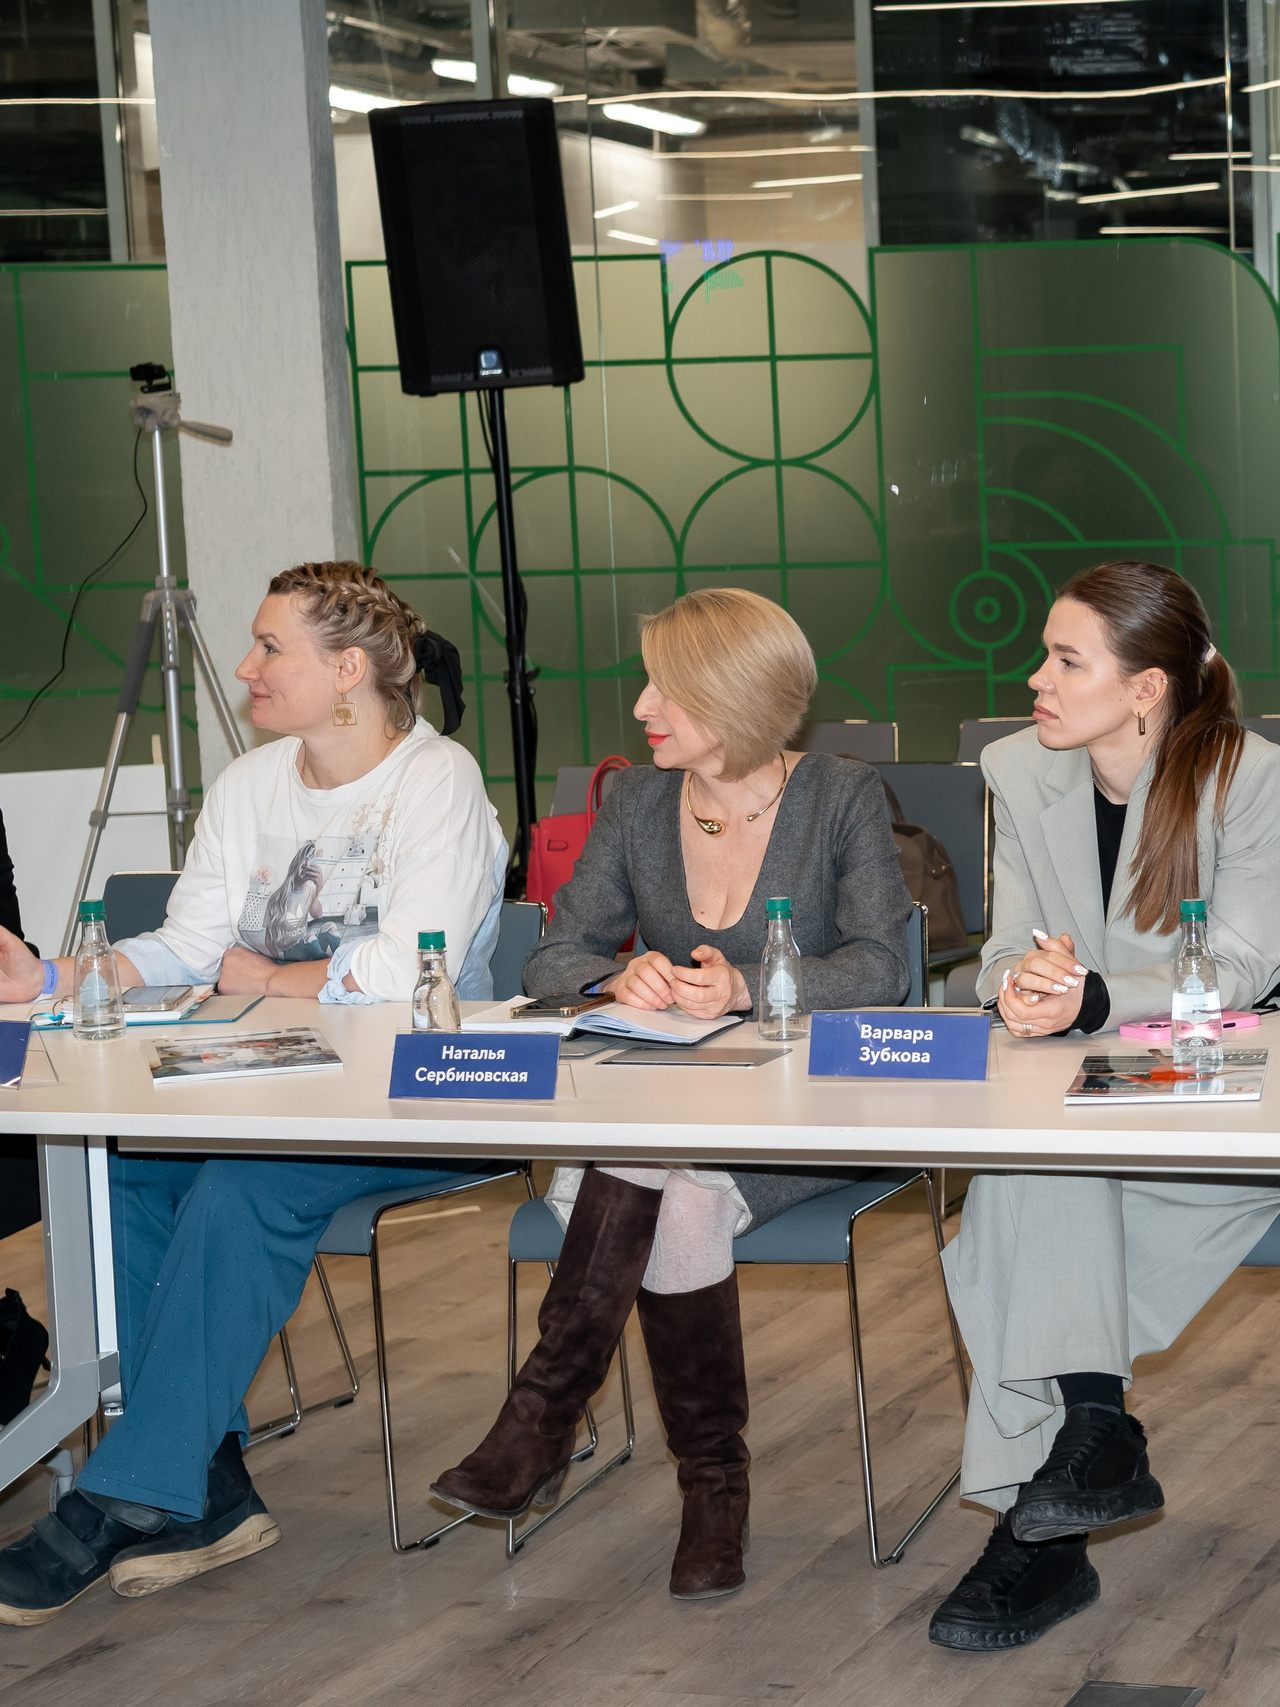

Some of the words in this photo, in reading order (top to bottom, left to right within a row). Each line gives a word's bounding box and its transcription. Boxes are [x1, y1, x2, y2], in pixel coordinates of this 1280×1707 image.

[860, 1024, 933, 1044] Варвара
[441, 1045, 505, 1060] Наталья
[859, 1047, 930, 1065] Зубкова
[415, 1067, 528, 1085] Сербиновская
